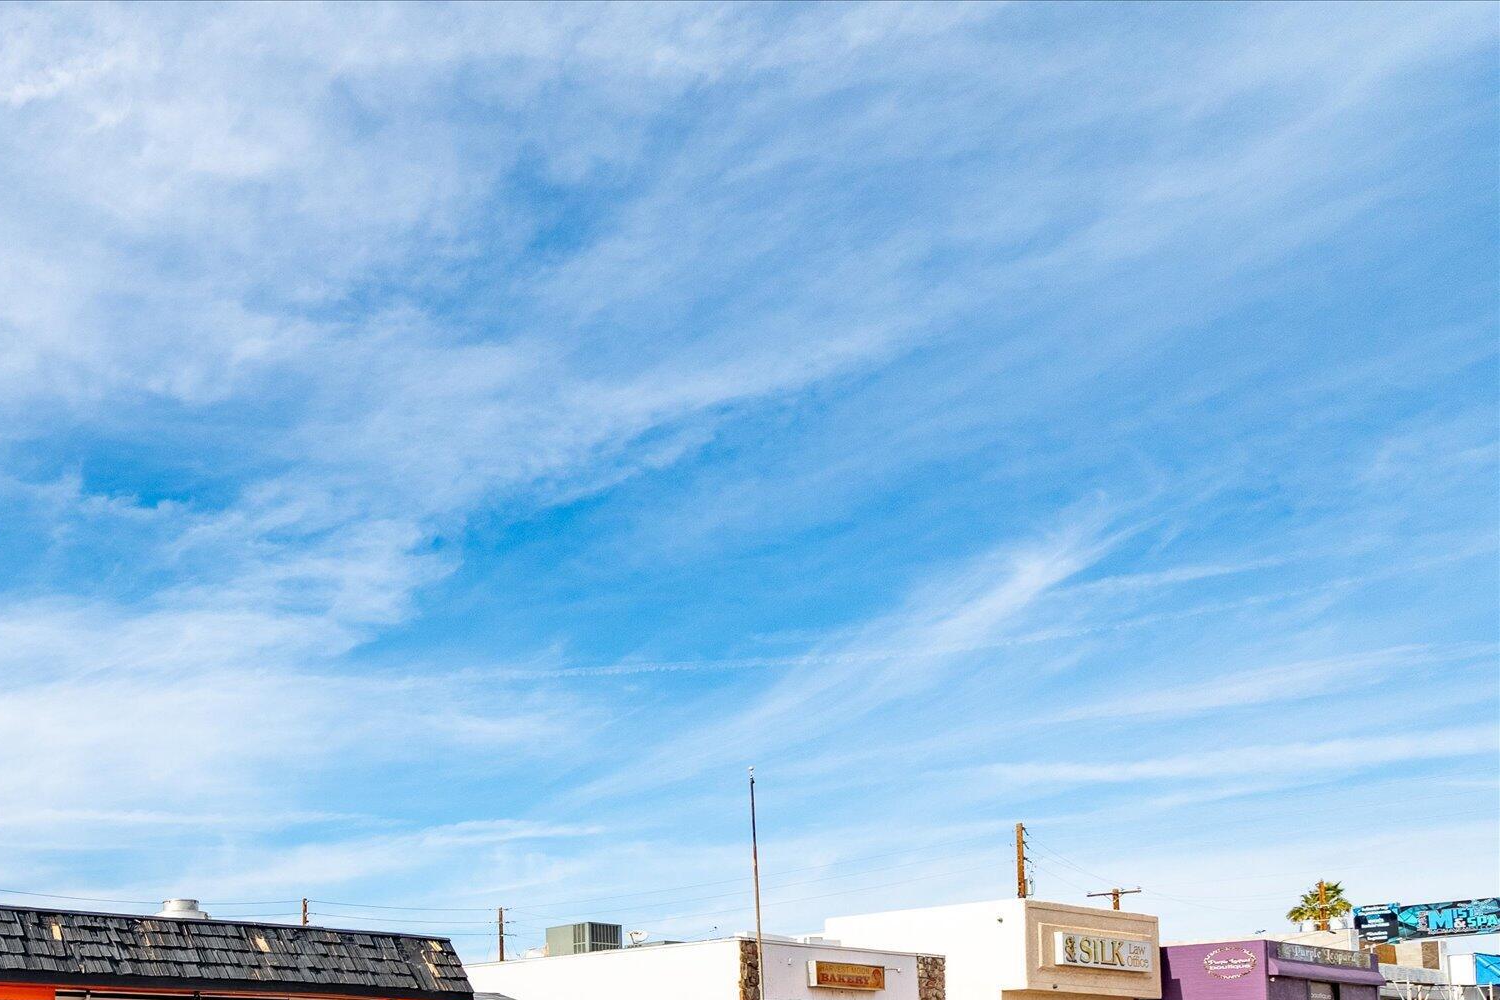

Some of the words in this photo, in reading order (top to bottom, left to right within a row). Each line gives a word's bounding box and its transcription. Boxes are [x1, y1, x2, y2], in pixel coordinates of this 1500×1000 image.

[1079, 936, 1125, 966] SILK
[1128, 943, 1146, 955] Law
[1293, 946, 1322, 962] Purple
[1126, 955, 1149, 968] Office
[820, 973, 871, 985] BAKERY
